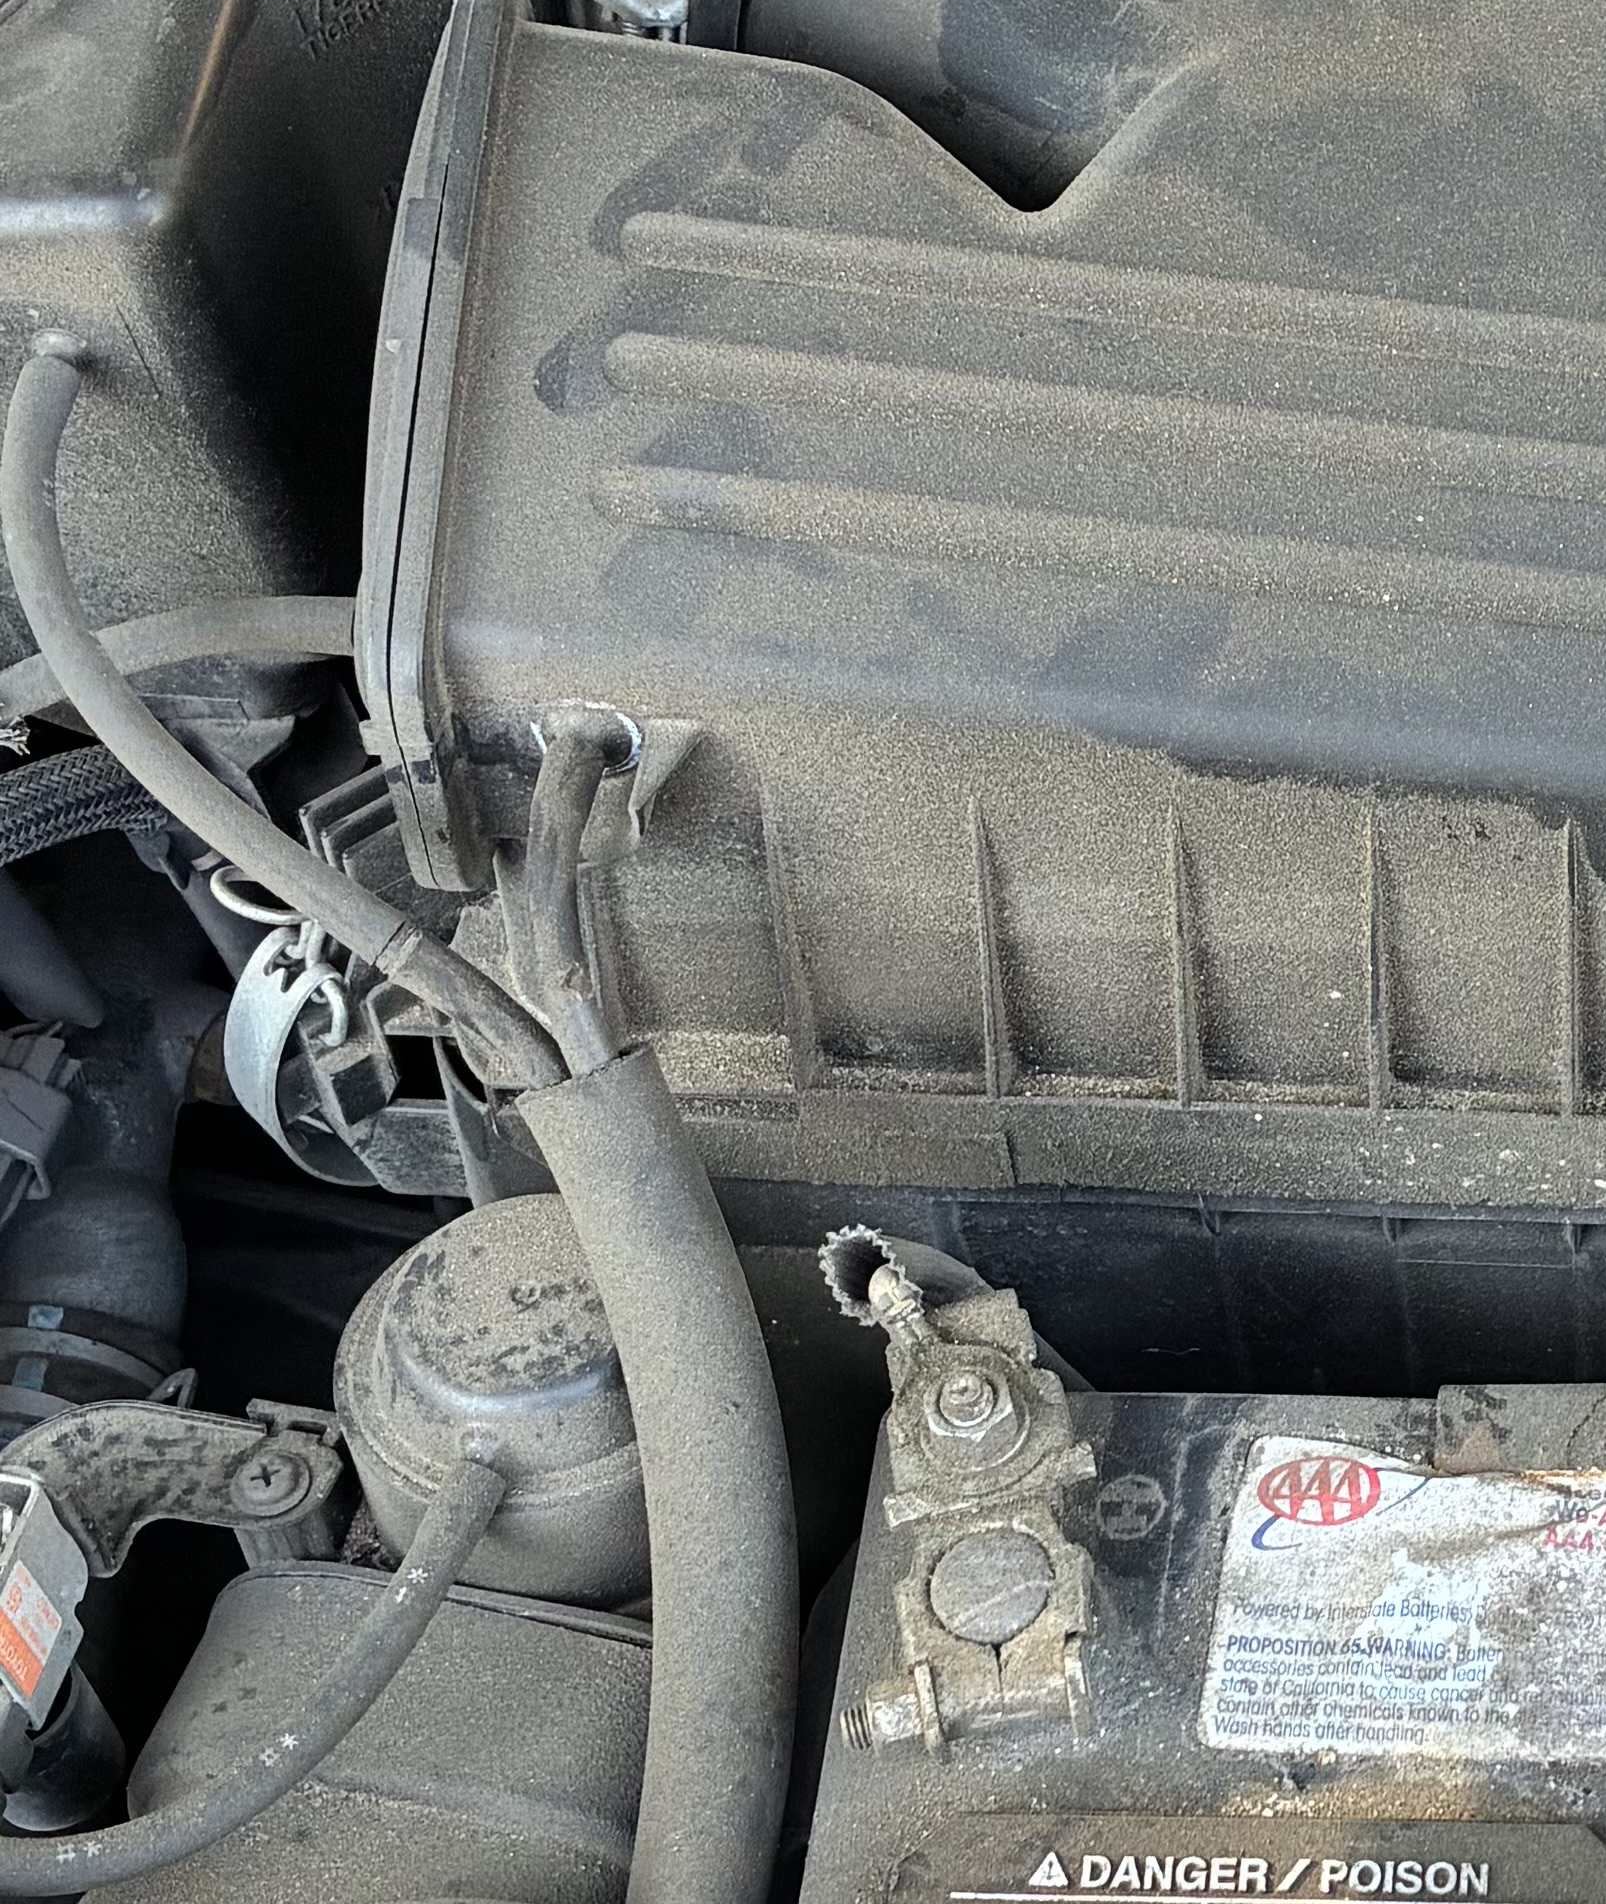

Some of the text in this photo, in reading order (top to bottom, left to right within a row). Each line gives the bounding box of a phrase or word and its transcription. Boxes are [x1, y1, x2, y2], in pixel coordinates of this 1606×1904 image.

[1266, 1457, 1366, 1525] AAA
[1303, 1601, 1324, 1624] by
[1328, 1600, 1396, 1622] Interstate
[1226, 1634, 1337, 1658] PROPOSITION
[1223, 1657, 1314, 1677] accessories
[1318, 1658, 1376, 1680] contain
[1380, 1660, 1413, 1681] lead
[1416, 1663, 1448, 1682] and
[1451, 1663, 1487, 1682] lead
[1219, 1676, 1258, 1696] state
[1262, 1678, 1279, 1696] of
[1282, 1678, 1355, 1699] California
[1359, 1680, 1375, 1699] to
[1379, 1683, 1427, 1701] cause
[1430, 1686, 1483, 1703] cancer
[1216, 1697, 1275, 1717] contain
[1280, 1700, 1319, 1718] other
[1323, 1701, 1402, 1722] chemicals
[1408, 1701, 1459, 1723] known
[1464, 1703, 1480, 1723] to
[1213, 1714, 1259, 1735] Wash
[1262, 1718, 1311, 1738] hands
[1315, 1720, 1351, 1741] after
[1080, 1854, 1269, 1894] DANGER
[1319, 1860, 1491, 1897] POISON
